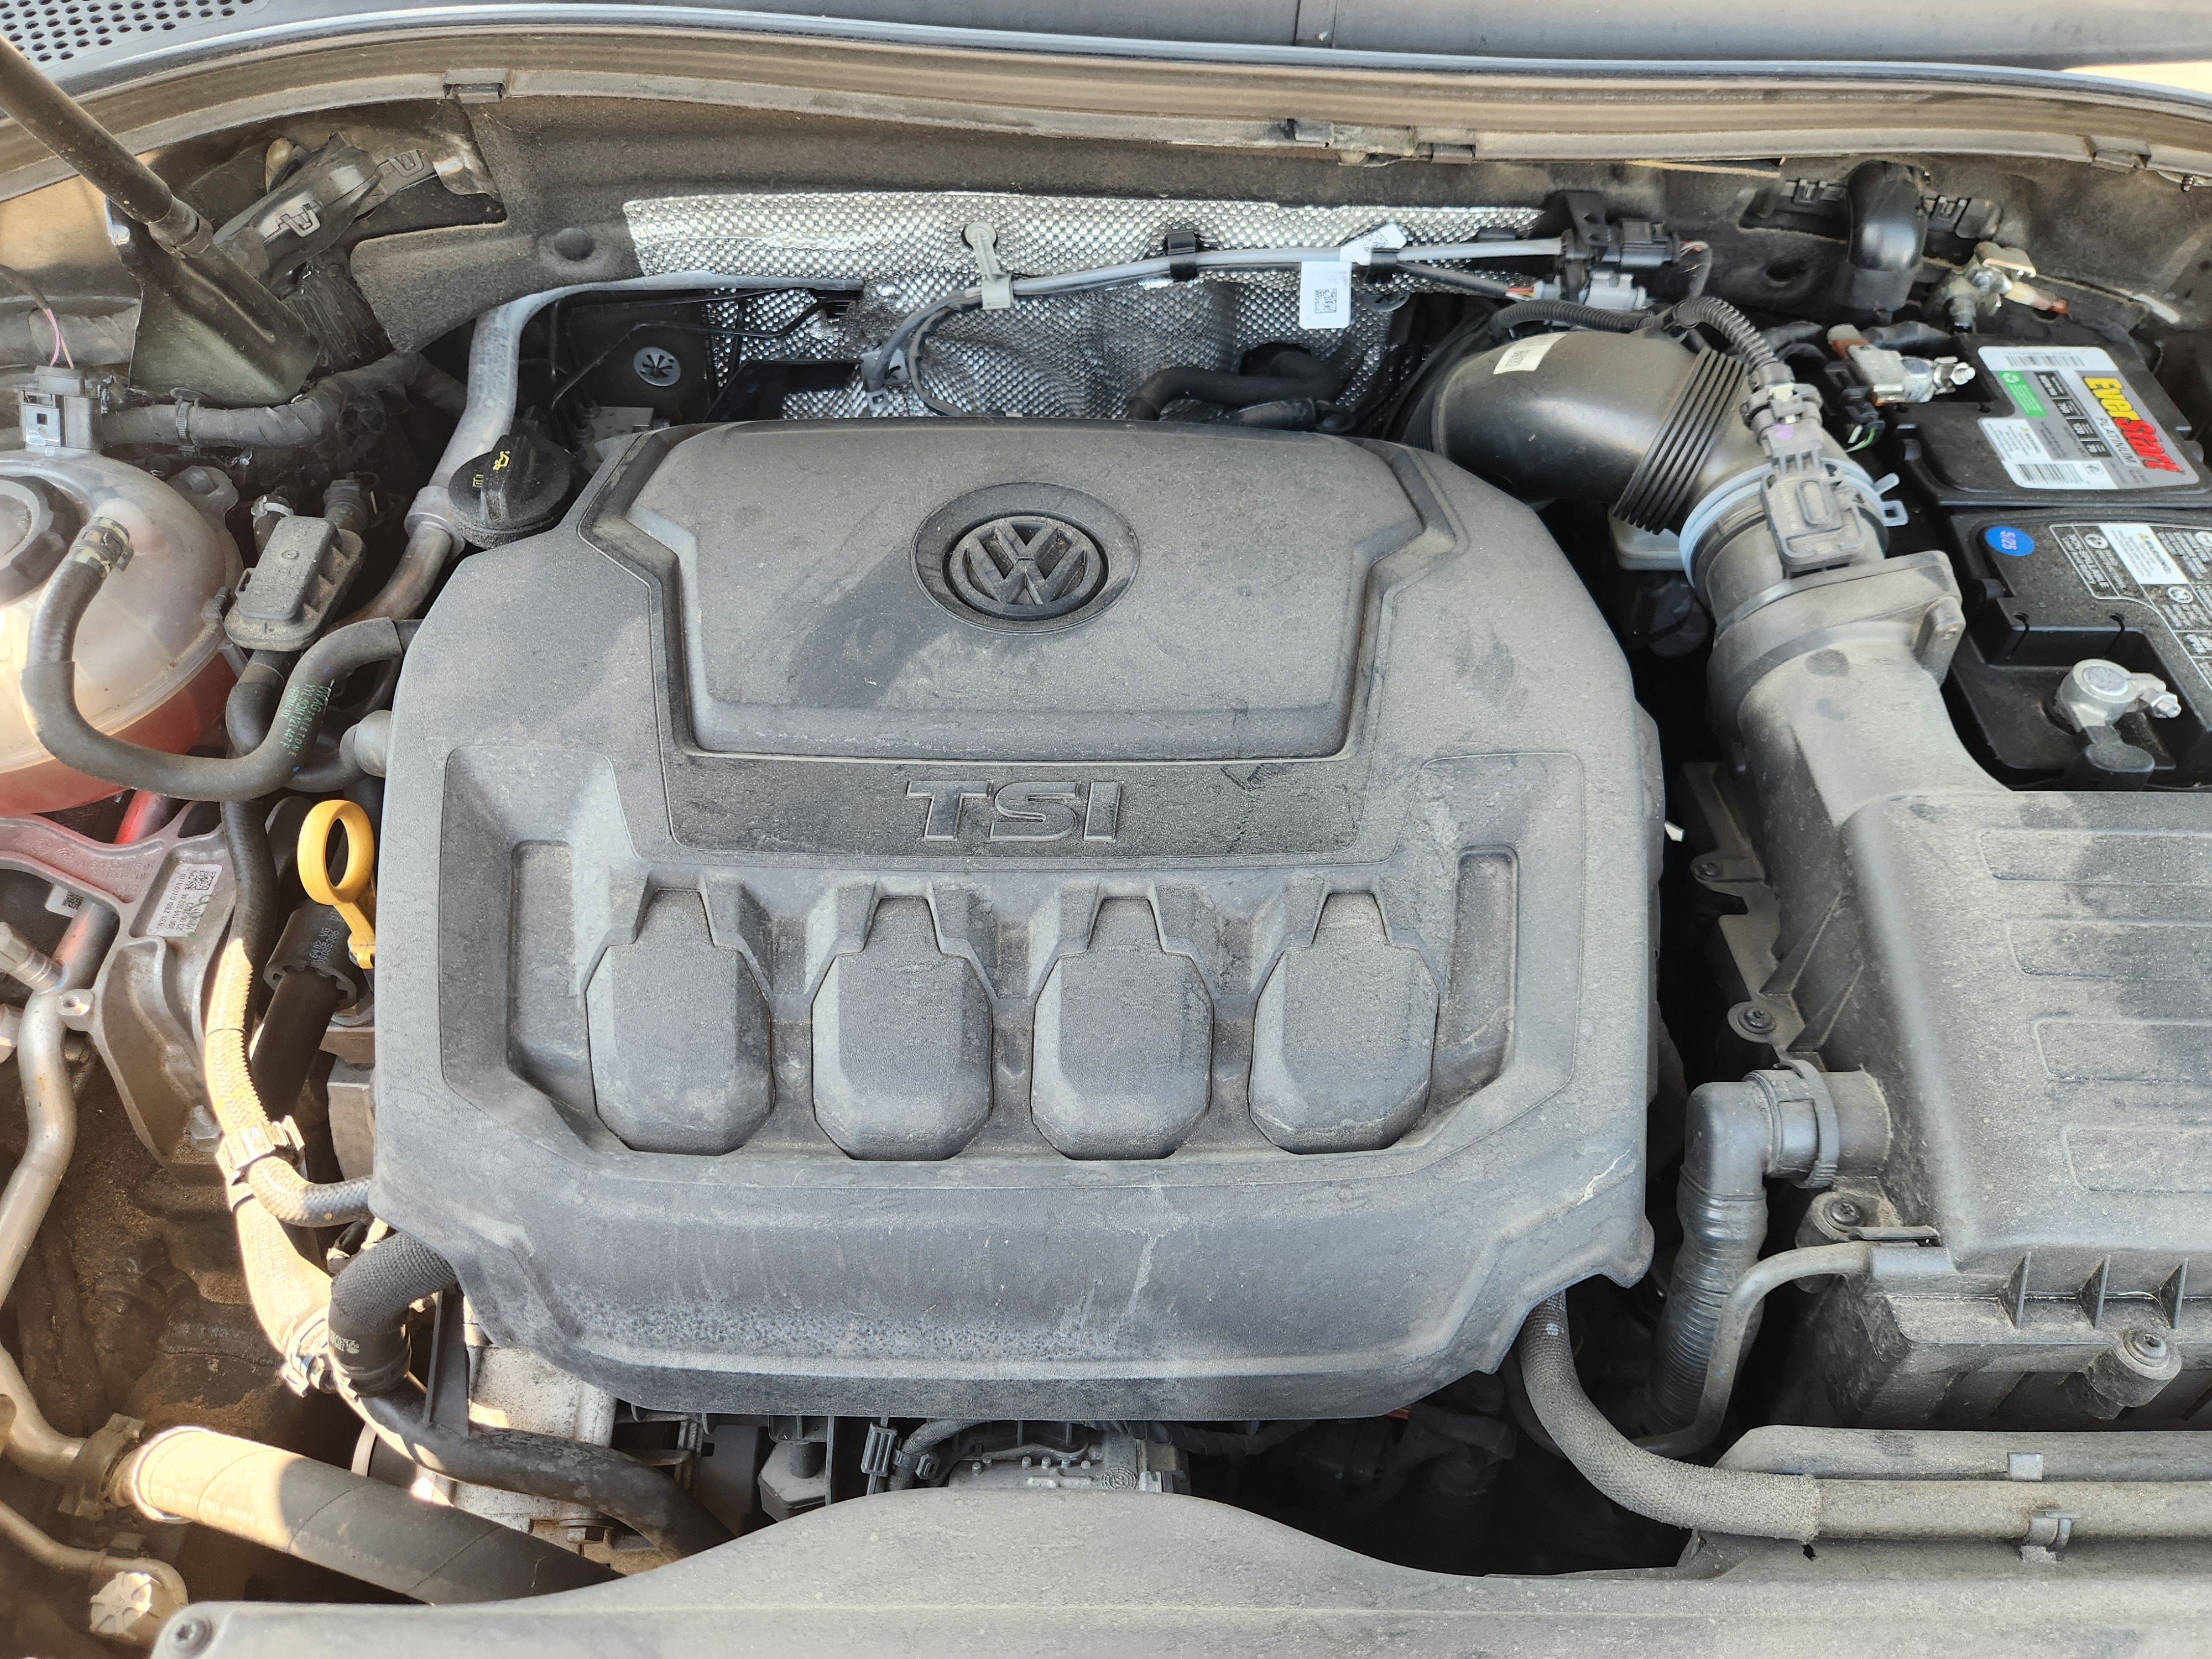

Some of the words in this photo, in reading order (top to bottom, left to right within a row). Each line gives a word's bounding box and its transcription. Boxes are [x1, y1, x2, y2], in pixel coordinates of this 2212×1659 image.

[2084, 377, 2184, 473] EverStart
[2096, 418, 2137, 463] PLATINUM
[952, 518, 1099, 608] VW
[1999, 530, 2018, 551] 5/25
[289, 711, 315, 758] TRISTONE
[906, 780, 1123, 842] TSI
